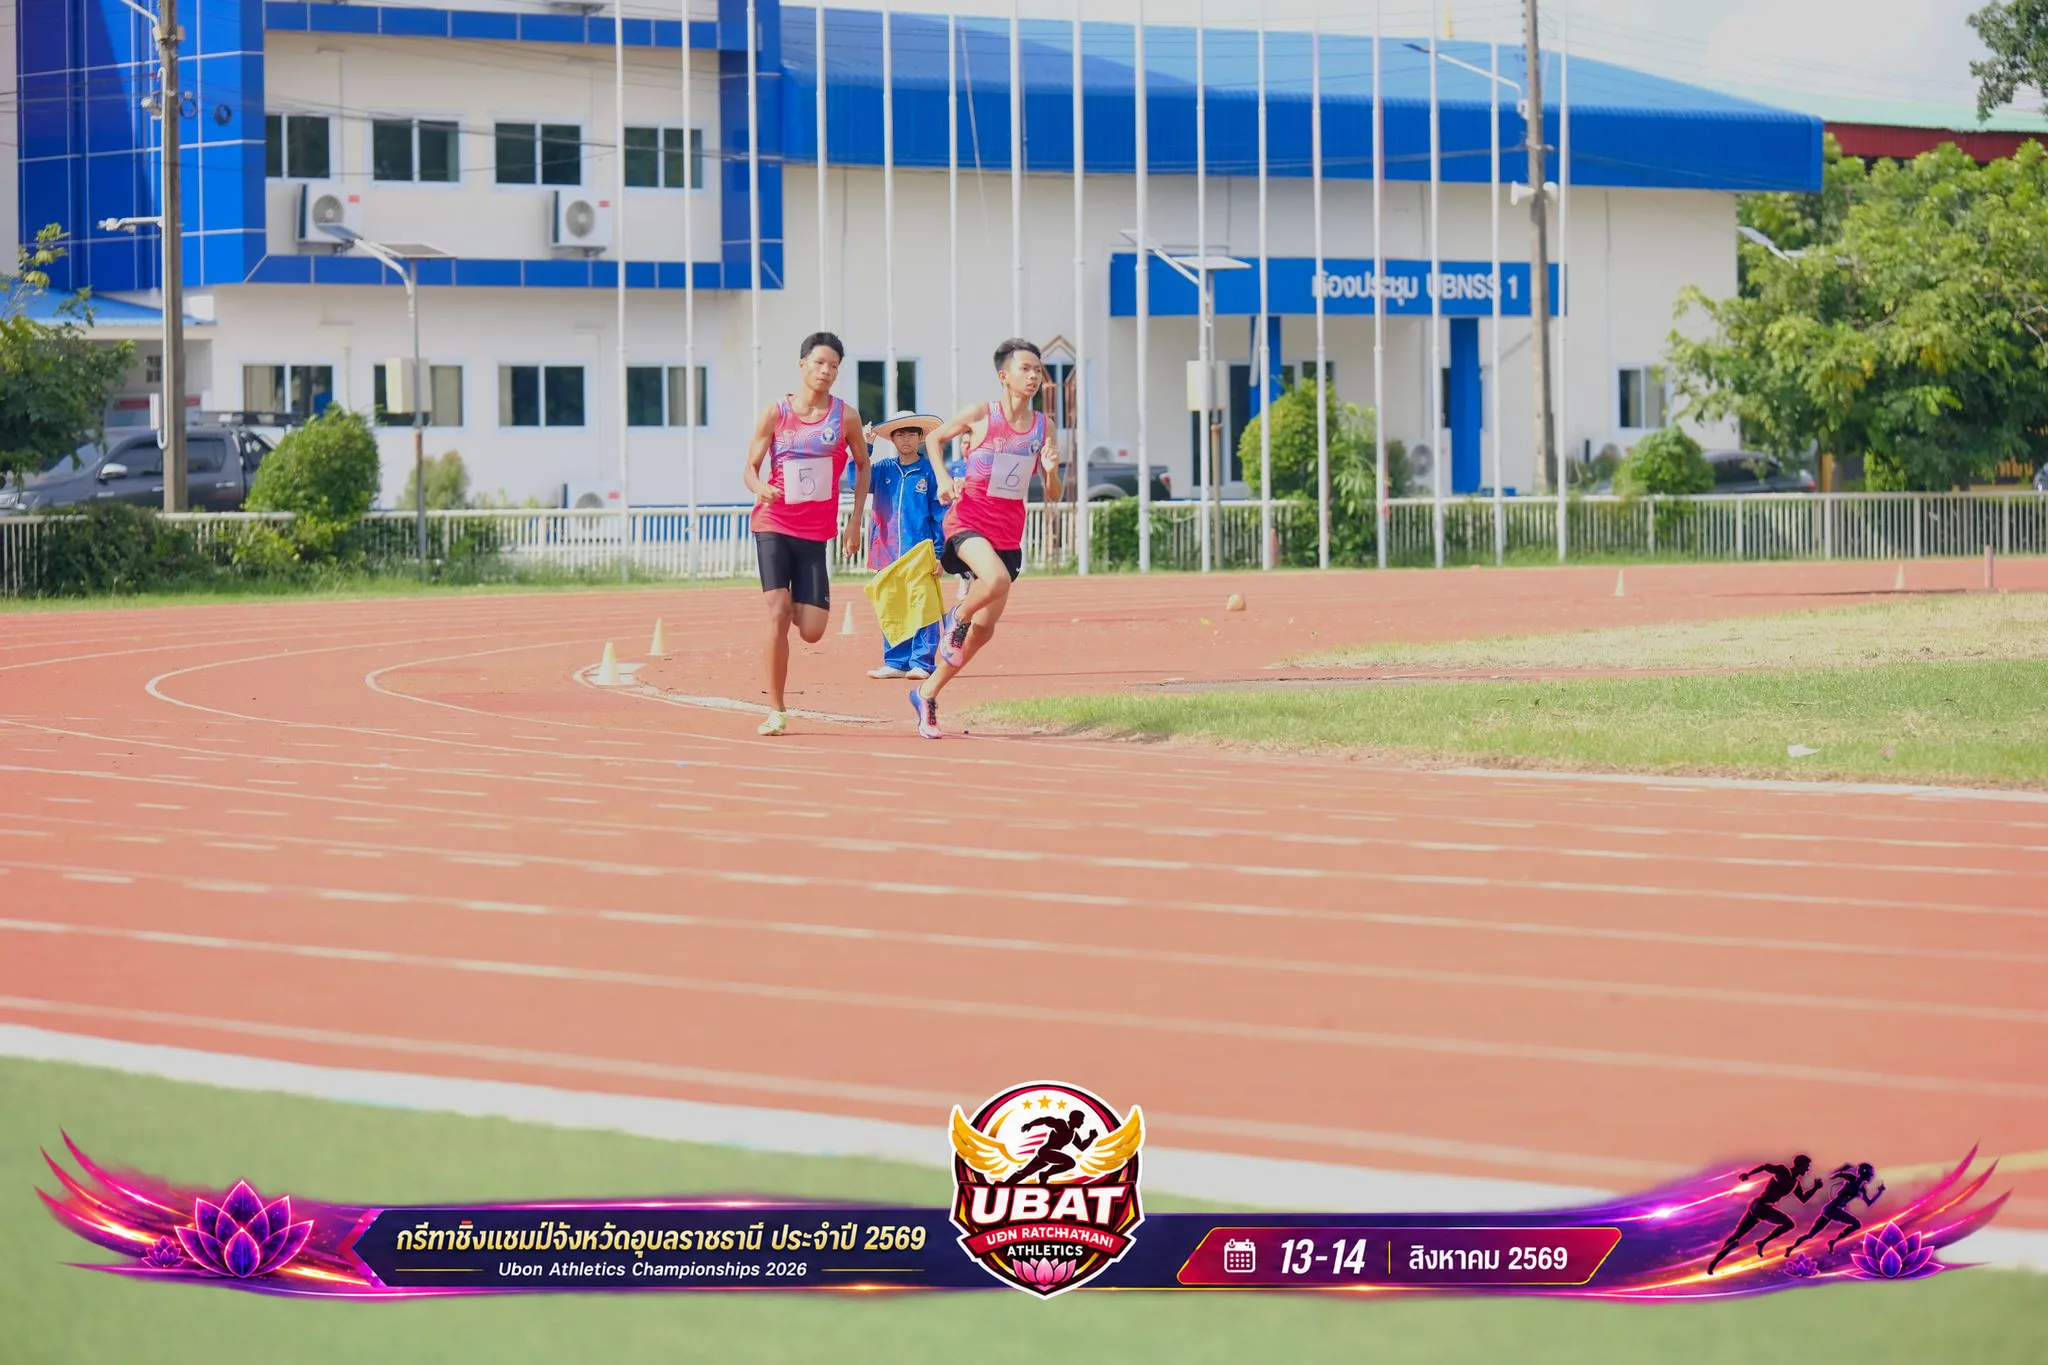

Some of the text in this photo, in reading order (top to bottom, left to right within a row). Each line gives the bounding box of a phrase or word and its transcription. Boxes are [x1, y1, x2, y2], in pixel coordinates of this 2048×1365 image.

[1507, 274, 1518, 300] 1
[799, 467, 816, 496] 5
[1005, 462, 1020, 488] 6
